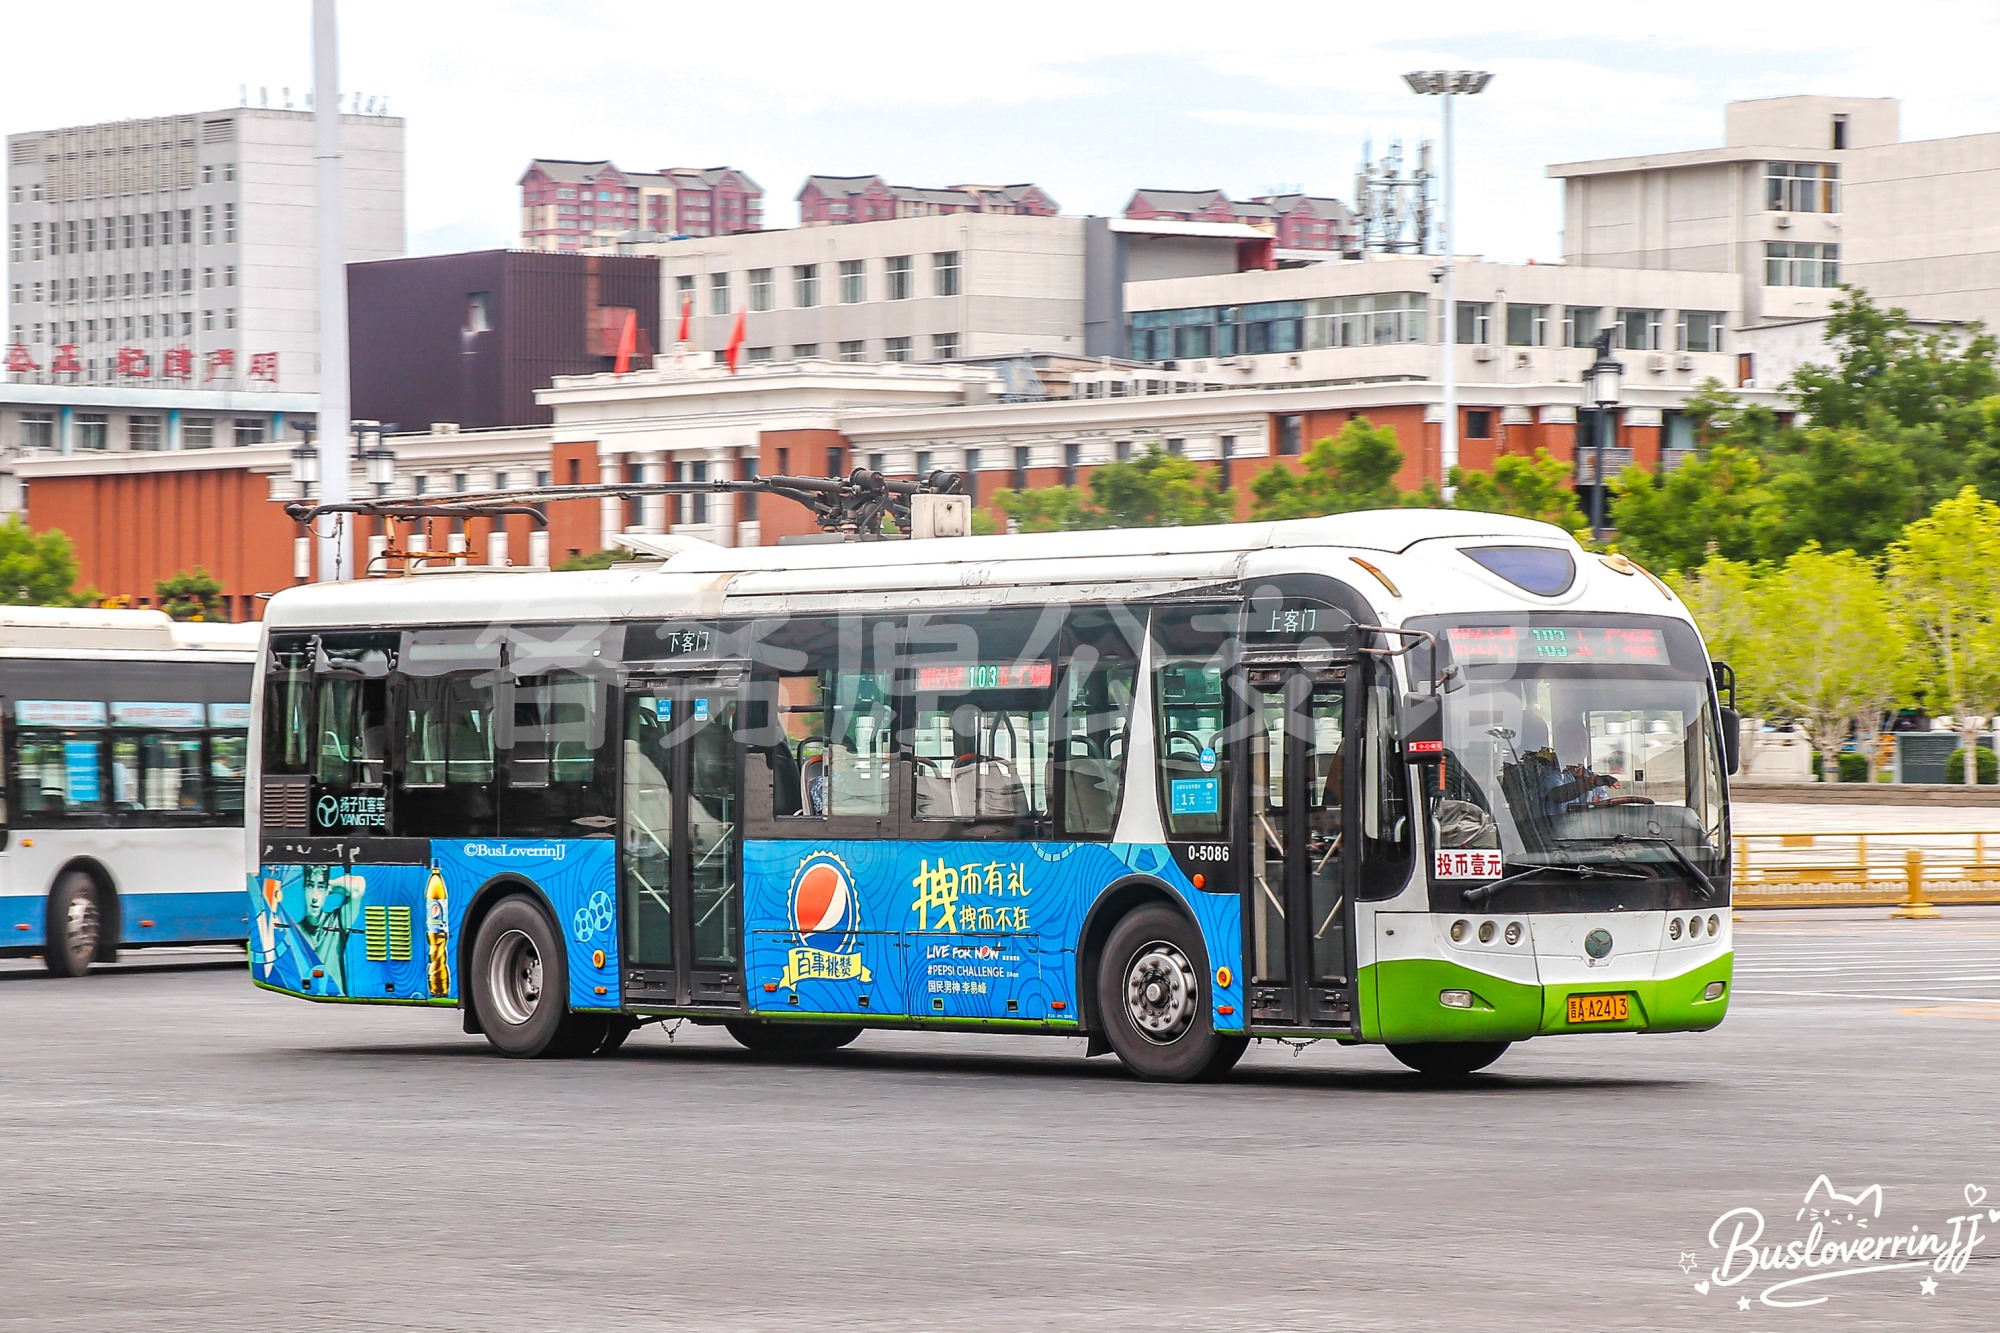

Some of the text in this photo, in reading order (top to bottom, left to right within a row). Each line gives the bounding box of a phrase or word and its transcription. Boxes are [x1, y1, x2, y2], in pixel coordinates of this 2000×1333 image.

[1266, 608, 1317, 633] 上客门
[668, 631, 710, 652] 下客门
[969, 665, 997, 688] 103
[340, 796, 386, 812] 扬子江客车
[340, 813, 386, 826] YANGTSE
[1437, 853, 1502, 876] 投币壹元
[959, 904, 1031, 931] 拽而不狂
[926, 944, 950, 959] LIVE
[952, 946, 973, 960] FOR
[927, 964, 955, 976] #PEPSI
[956, 965, 1005, 977] CHALLENGE
[928, 980, 987, 995] 国民男神 李易峰
